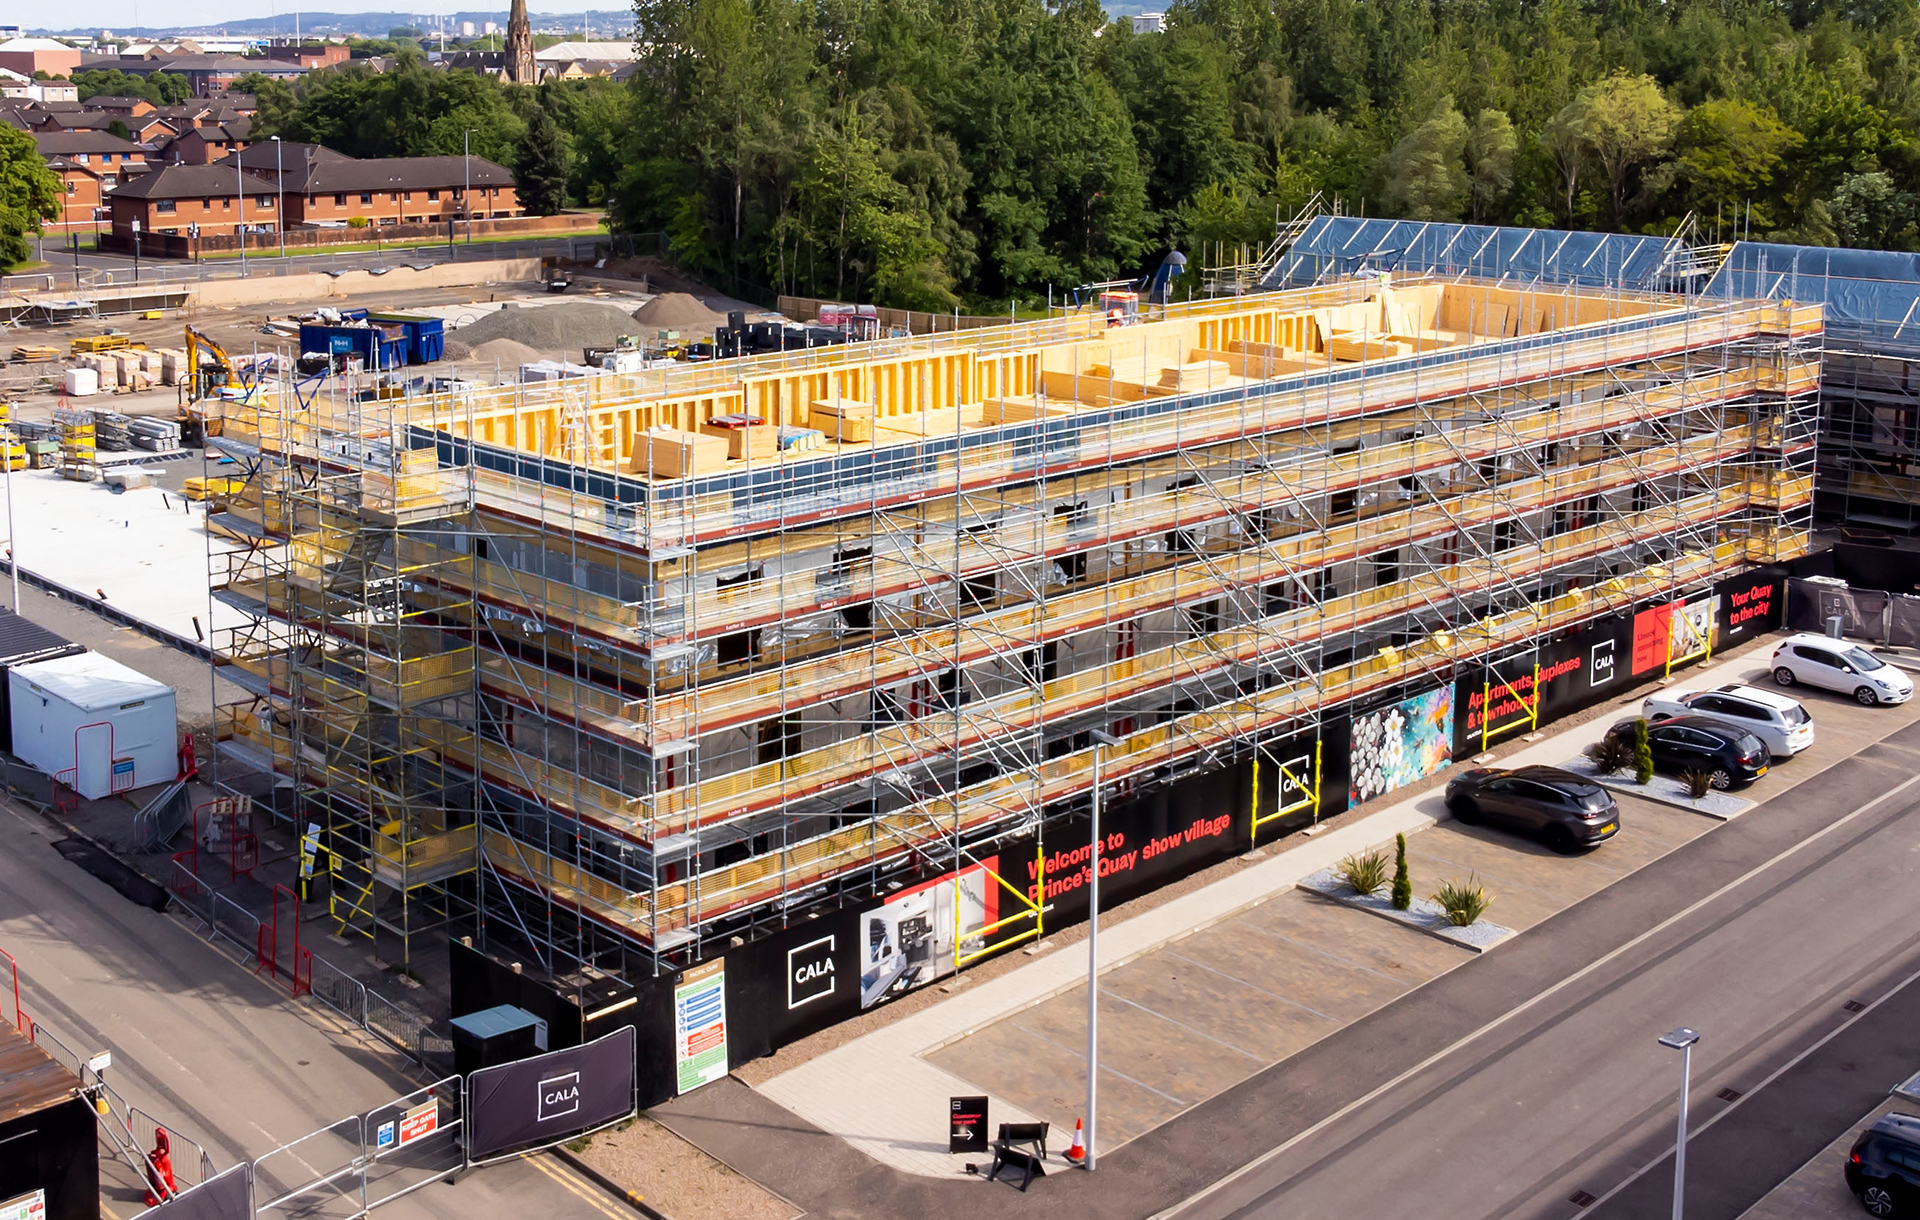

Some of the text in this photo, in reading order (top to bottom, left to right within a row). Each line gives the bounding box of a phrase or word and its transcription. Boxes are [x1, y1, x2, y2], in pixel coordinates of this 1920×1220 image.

[1731, 584, 1772, 607] Your Quay
[1730, 601, 1769, 625] to the city
[1825, 605, 1850, 616] CALA
[1595, 654, 1614, 670] CALA
[1468, 656, 1581, 710] Aprtments, duplexes
[1467, 712, 1476, 729] &
[1283, 773, 1309, 792] CALA
[1027, 833, 1125, 880] Welcome to
[1097, 850, 1138, 878] Quay
[1142, 831, 1182, 860] show
[1184, 814, 1230, 843] village
[795, 957, 835, 984] CALA
[545, 1086, 579, 1105] CALA
[402, 1111, 435, 1132] KEEP GATE
[410, 1123, 428, 1136] SHUT
